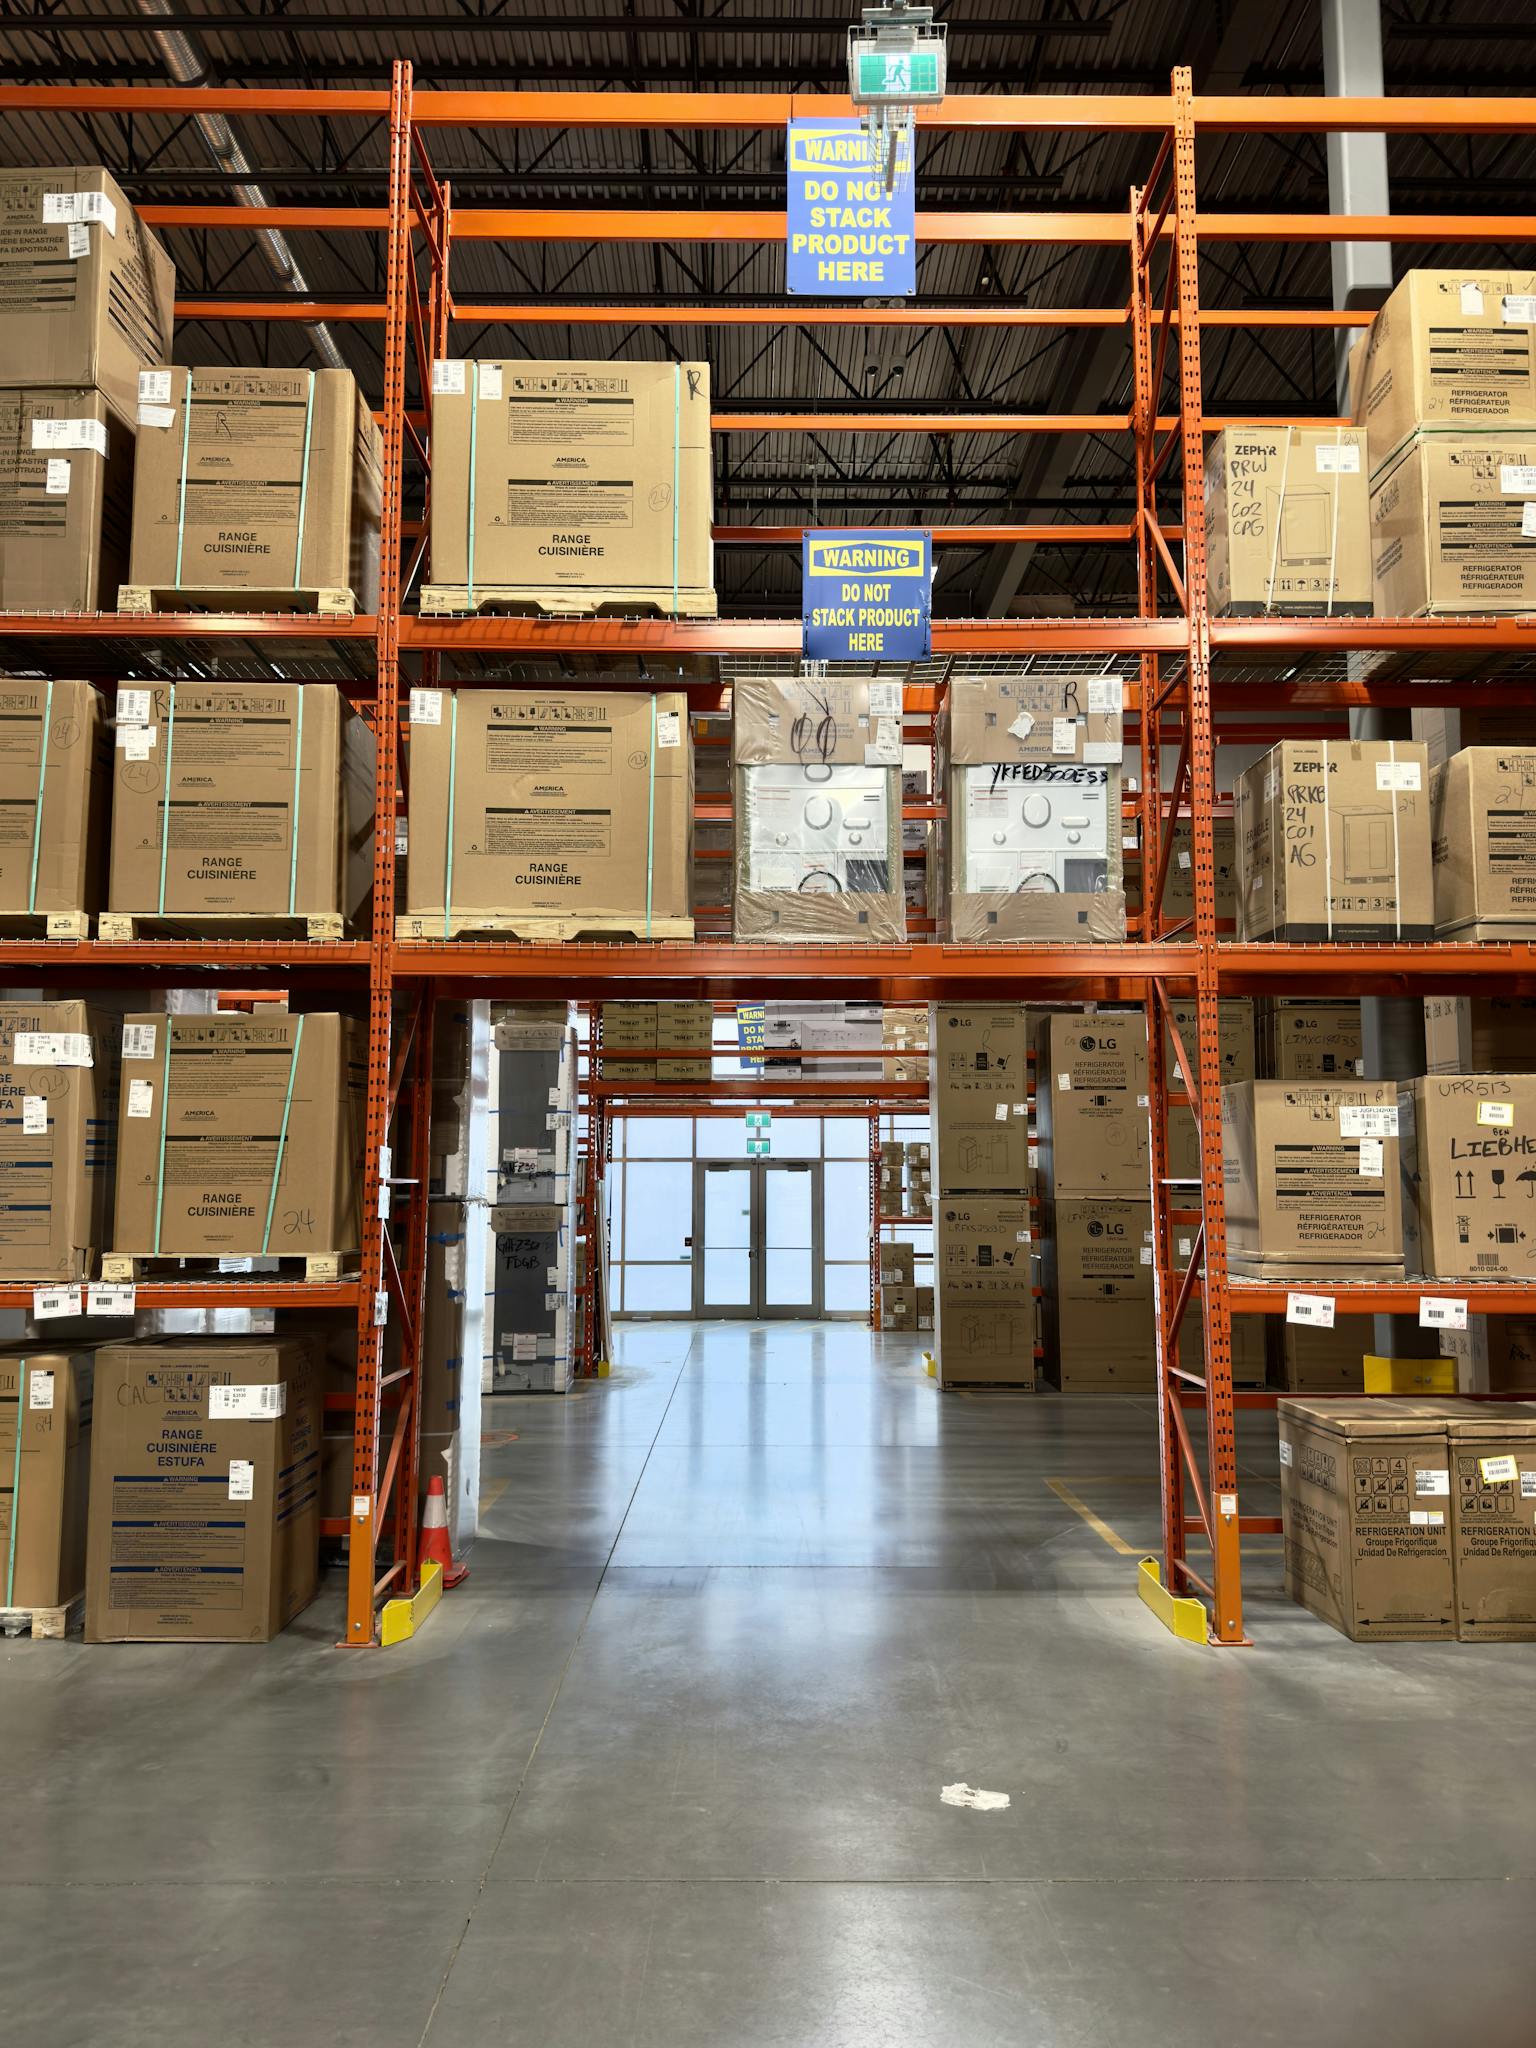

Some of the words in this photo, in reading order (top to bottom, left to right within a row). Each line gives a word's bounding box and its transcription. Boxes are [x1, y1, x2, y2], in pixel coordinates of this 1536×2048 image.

[805, 139, 882, 161] WARNI
[804, 180, 838, 201] DO
[810, 207, 891, 228] STACK
[10, 245, 59, 254] EMPOTRADA
[792, 233, 910, 255] PRODUCT
[818, 261, 884, 282] HERE
[687, 369, 706, 400] R
[1451, 390, 1508, 398] REFRIGERATOR
[1451, 407, 1509, 415] REFRIGERADOR
[1231, 458, 1267, 478] PRW
[1232, 480, 1255, 498] 24
[1233, 519, 1264, 536] CPG
[218, 532, 258, 541] RANGE
[552, 534, 591, 544] RANGE
[203, 543, 271, 554] CUISINIÈRE
[538, 545, 605, 556] CUISINIÈRE
[823, 549, 910, 567] WARNING
[1460, 572, 1525, 580] RÉFRIGÉRATEUR
[1462, 582, 1523, 590] REFRIGERADOR
[842, 584, 861, 602] DO
[864, 584, 892, 602] NOT
[812, 608, 855, 627] STACK
[858, 608, 921, 627] PRODUCT
[849, 633, 884, 651] HERE
[1064, 681, 1081, 713] R
[1286, 807, 1306, 823] 24
[1290, 842, 1316, 867] AG
[202, 858, 242, 867] RANGE
[529, 863, 568, 873] RANGE
[187, 869, 257, 880] CUISINIÈRE
[515, 874, 582, 885] CUISINIÈRE
[960, 1018, 972, 1027] LG
[1305, 1020, 1318, 1028] LG
[743, 1026, 756, 1034] DO
[1099, 1038, 1117, 1050] LG
[203, 1193, 242, 1204] RANGE
[187, 1205, 256, 1217] CUISINIÈRE
[958, 1212, 970, 1221] LG
[283, 1208, 315, 1234] 24
[1297, 1222, 1365, 1230] RÉFRIGÉRATEUR
[1106, 1223, 1125, 1235] LG
[1299, 1232, 1363, 1240] REFRIGERADOR
[162, 1430, 203, 1440] RANGE
[146, 1441, 217, 1453] CUISINIÈRE
[158, 1456, 205, 1467] ESTUFA
[1355, 1527, 1425, 1536] REFRIGERATION
[1427, 1526, 1447, 1536] UNIT
[1461, 1527, 1531, 1536] REFRIGERATION
[1365, 1538, 1394, 1547] Groupe
[1395, 1537, 1438, 1547] Frigorifique
[1471, 1537, 1499, 1547] Groupe
[1358, 1548, 1385, 1557] Unidad
[1386, 1548, 1397, 1556] De
[1463, 1548, 1490, 1556] Unidad
[1491, 1548, 1501, 1556] De
